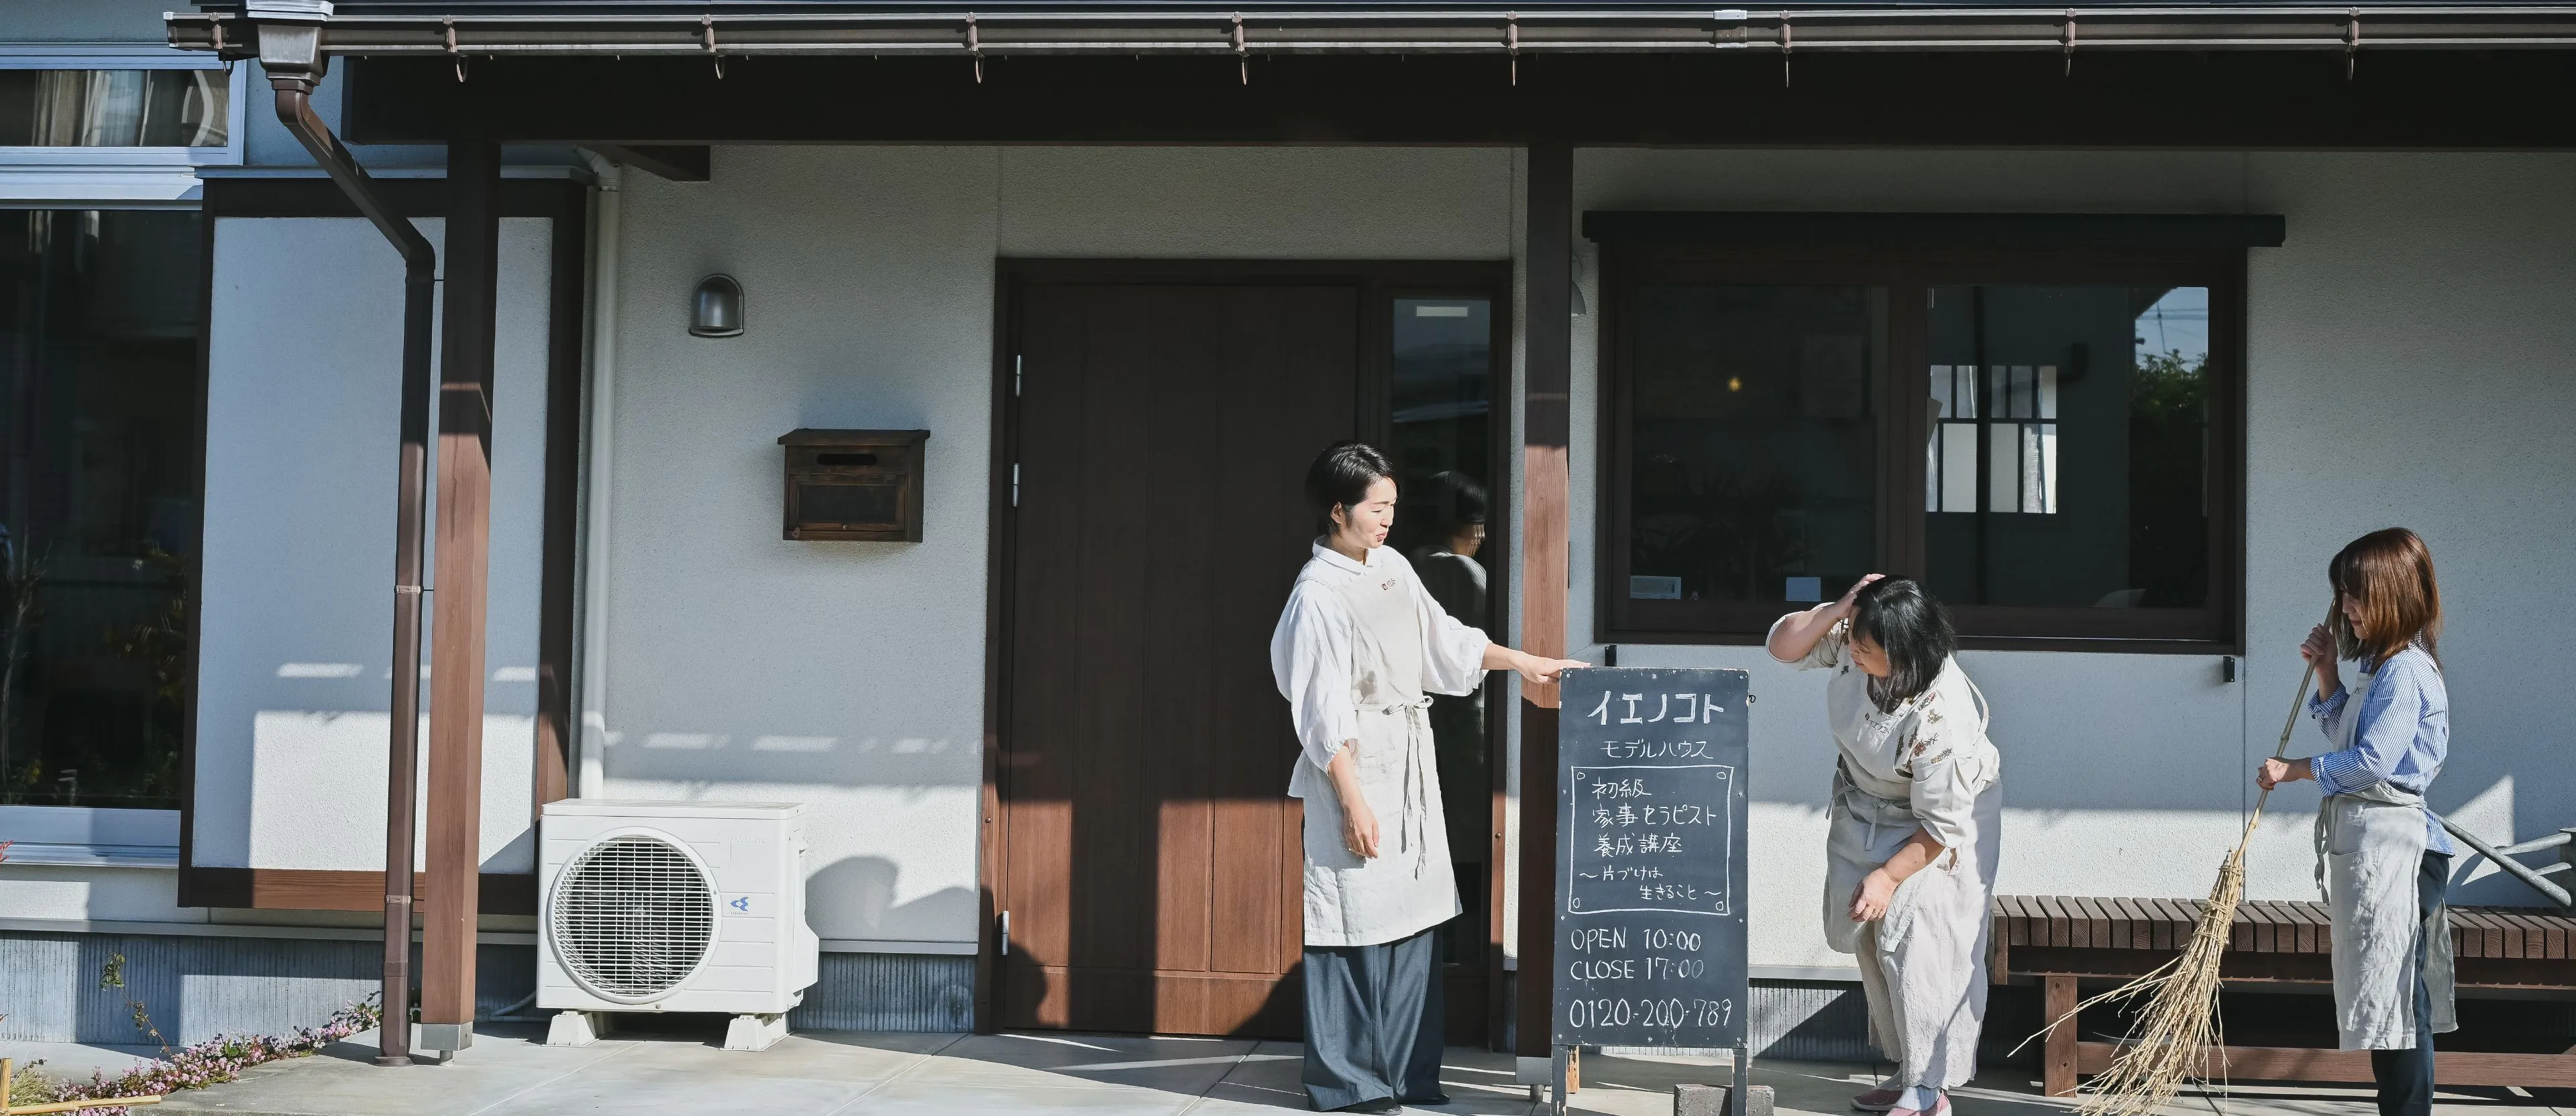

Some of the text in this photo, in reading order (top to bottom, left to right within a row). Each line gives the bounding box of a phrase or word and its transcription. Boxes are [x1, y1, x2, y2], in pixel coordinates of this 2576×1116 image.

[1587, 690, 1724, 726] イエノコト
[1600, 738, 1714, 759] モデルハウス
[1591, 775, 1653, 800] 初級
[1592, 801, 1717, 828] 家事セラピスト
[1593, 832, 1683, 858] 養成講座
[1570, 926, 1702, 954] OPEN 10:00
[1570, 956, 1704, 981] CLOSE 17:00
[1569, 997, 1732, 1028] 0120-200-789
